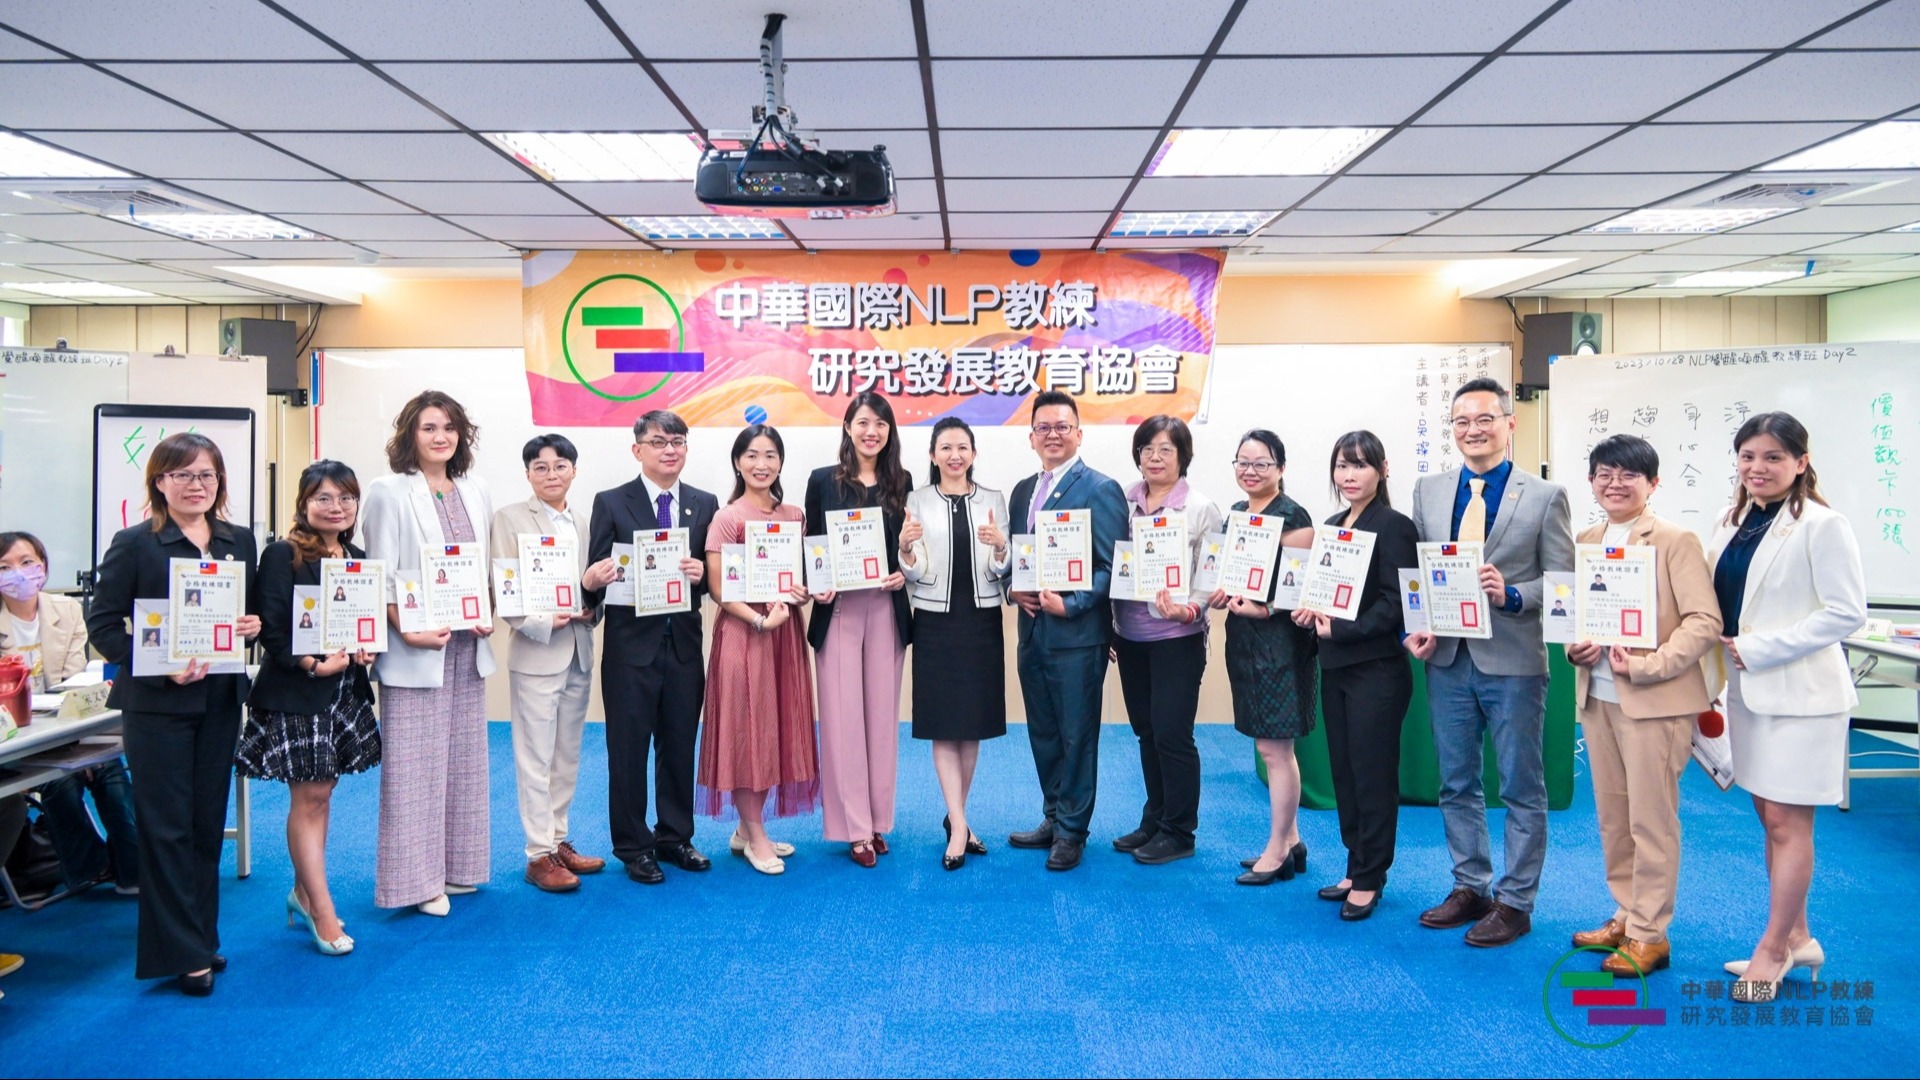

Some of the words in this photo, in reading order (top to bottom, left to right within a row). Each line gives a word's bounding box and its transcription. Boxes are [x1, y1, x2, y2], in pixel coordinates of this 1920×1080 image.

[714, 279, 1099, 331] 中華國際NLP教練
[806, 343, 1184, 395] 研究發展教育協會
